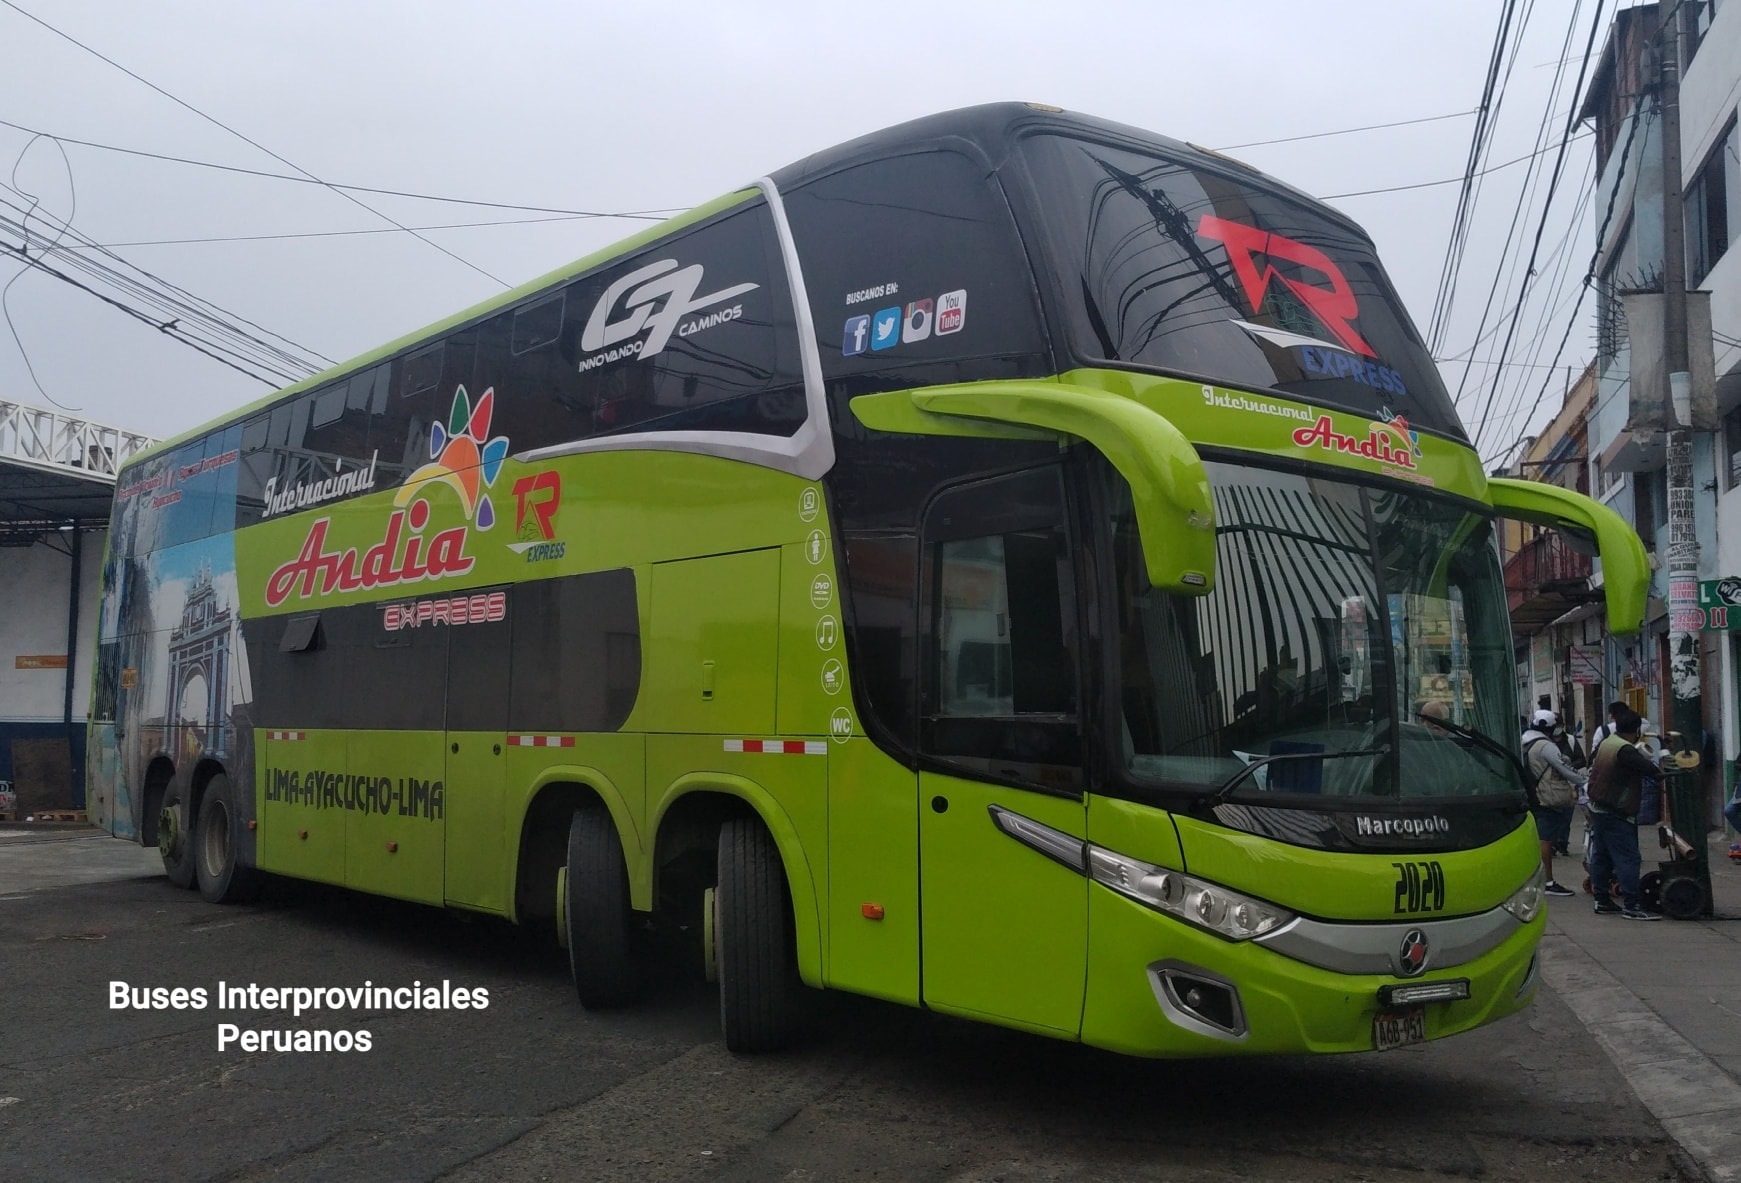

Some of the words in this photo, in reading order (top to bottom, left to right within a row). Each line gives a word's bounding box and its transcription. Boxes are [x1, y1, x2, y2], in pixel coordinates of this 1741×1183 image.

[846, 285, 885, 305] BUSCANOS
[885, 282, 899, 295] EN:
[945, 295, 959, 309] You
[679, 304, 743, 337] CAMINOS
[941, 314, 960, 330] Tube
[578, 340, 643, 373] INNOVANDO
[1302, 346, 1407, 396] EXPRESS
[1201, 384, 1316, 423] Internacional
[1292, 415, 1418, 470] Andia
[262, 449, 379, 518] Internacional
[265, 498, 476, 607] Andia
[527, 542, 566, 563] EXPRESS
[815, 582, 829, 590] DVD
[384, 592, 506, 631] EXPRESS
[833, 718, 850, 733] WC
[266, 768, 443, 822] LIMA-AYACUCHO-LIMA
[1356, 815, 1449, 836] Marcopolo
[1392, 861, 1445, 914] 2020
